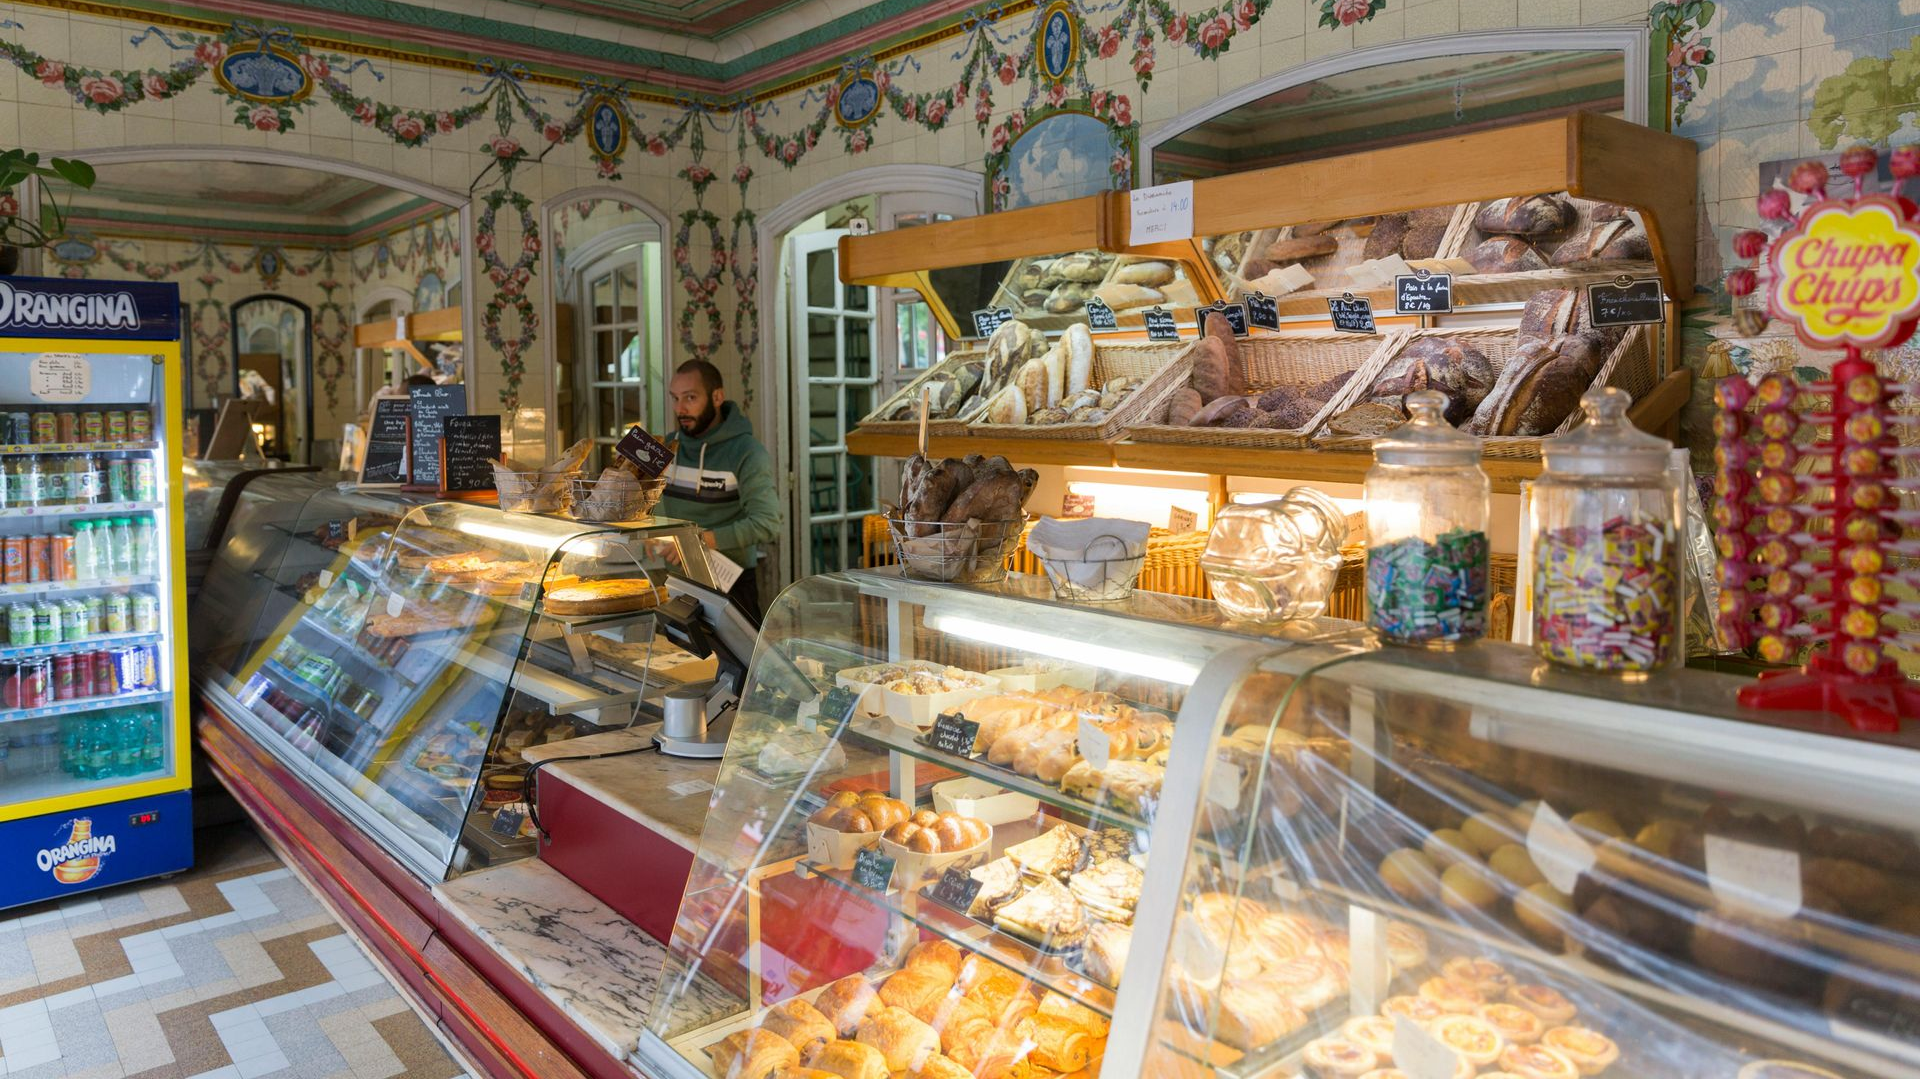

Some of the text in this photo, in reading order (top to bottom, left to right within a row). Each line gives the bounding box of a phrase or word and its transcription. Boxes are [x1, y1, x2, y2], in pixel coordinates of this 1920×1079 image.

[1795, 237, 1911, 276] Chupa
[1788, 272, 1902, 326] Chups
[37, 835, 116, 872] ORANGINA
